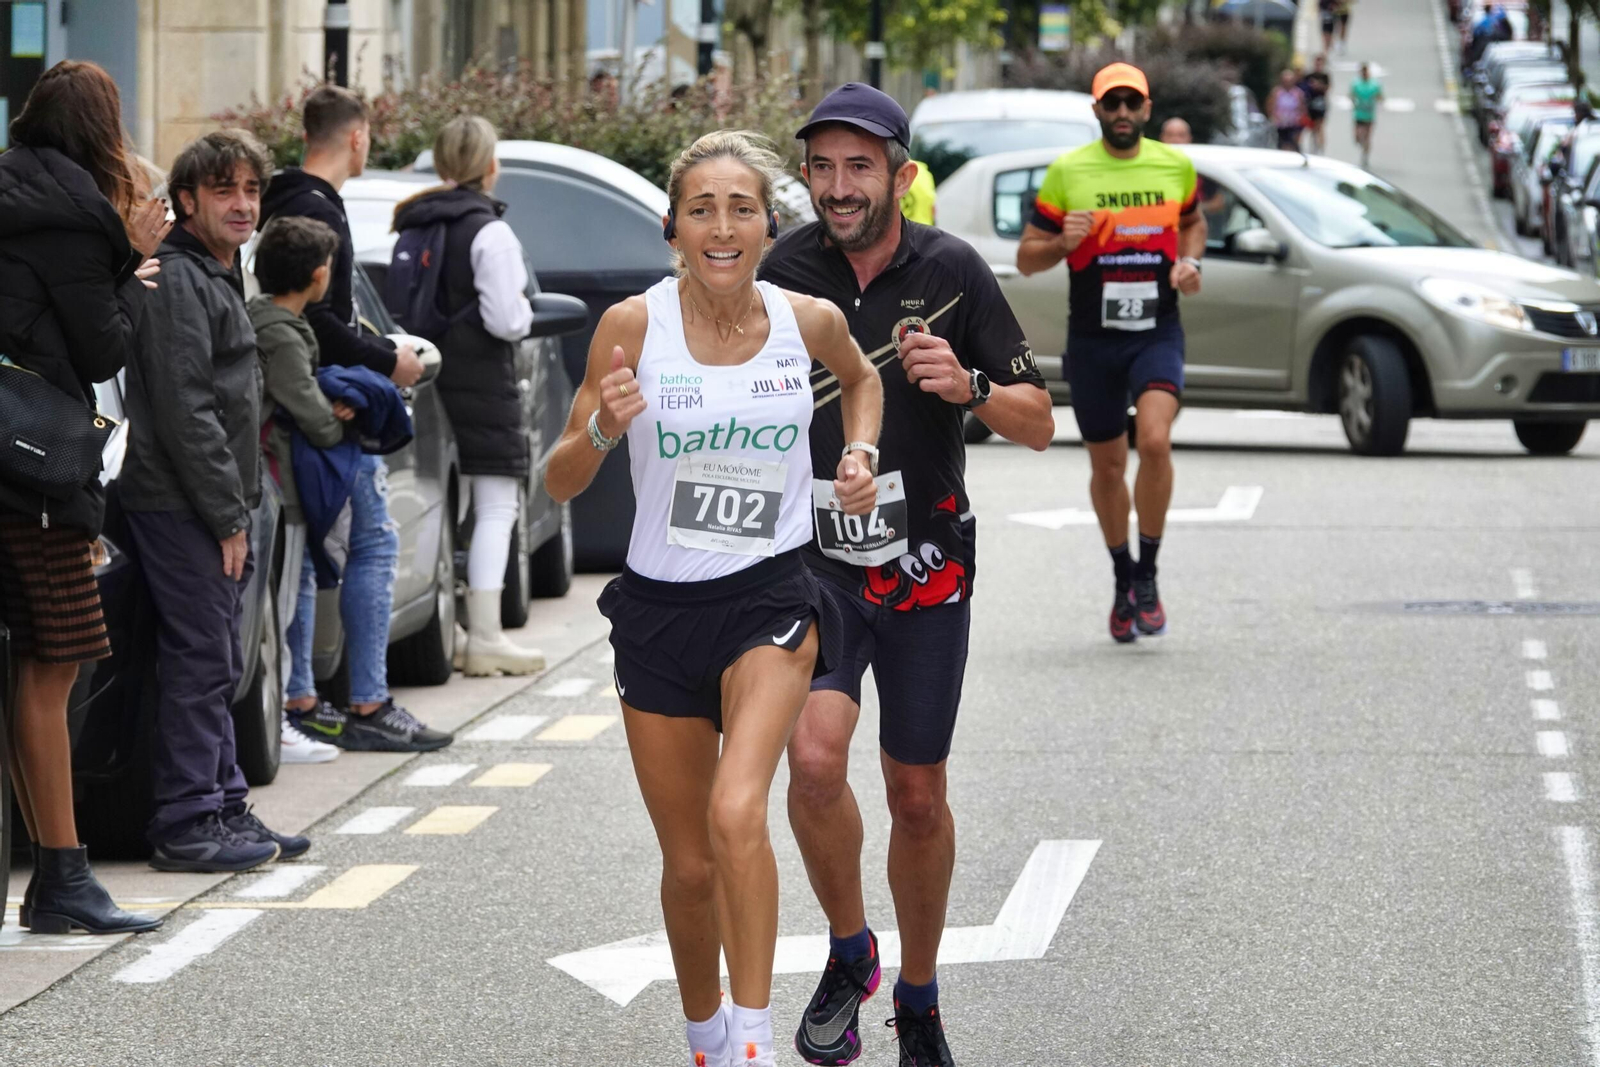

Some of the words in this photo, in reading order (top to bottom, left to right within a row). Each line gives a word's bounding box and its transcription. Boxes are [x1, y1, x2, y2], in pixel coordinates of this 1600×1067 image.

[1096, 190, 1165, 208] 3NORTH
[1117, 299, 1144, 318] 28
[776, 358, 799, 369] NATI
[660, 373, 703, 385] bathco
[750, 374, 803, 394] JULIÁN
[661, 385, 700, 395] running
[658, 394, 703, 410] TEAM
[656, 417, 799, 459] bathco
[703, 463, 716, 472] EU
[693, 485, 766, 529] 702
[707, 523, 726, 531] Natalia
[726, 526, 742, 534] RIVAS
[830, 506, 887, 543] 104
